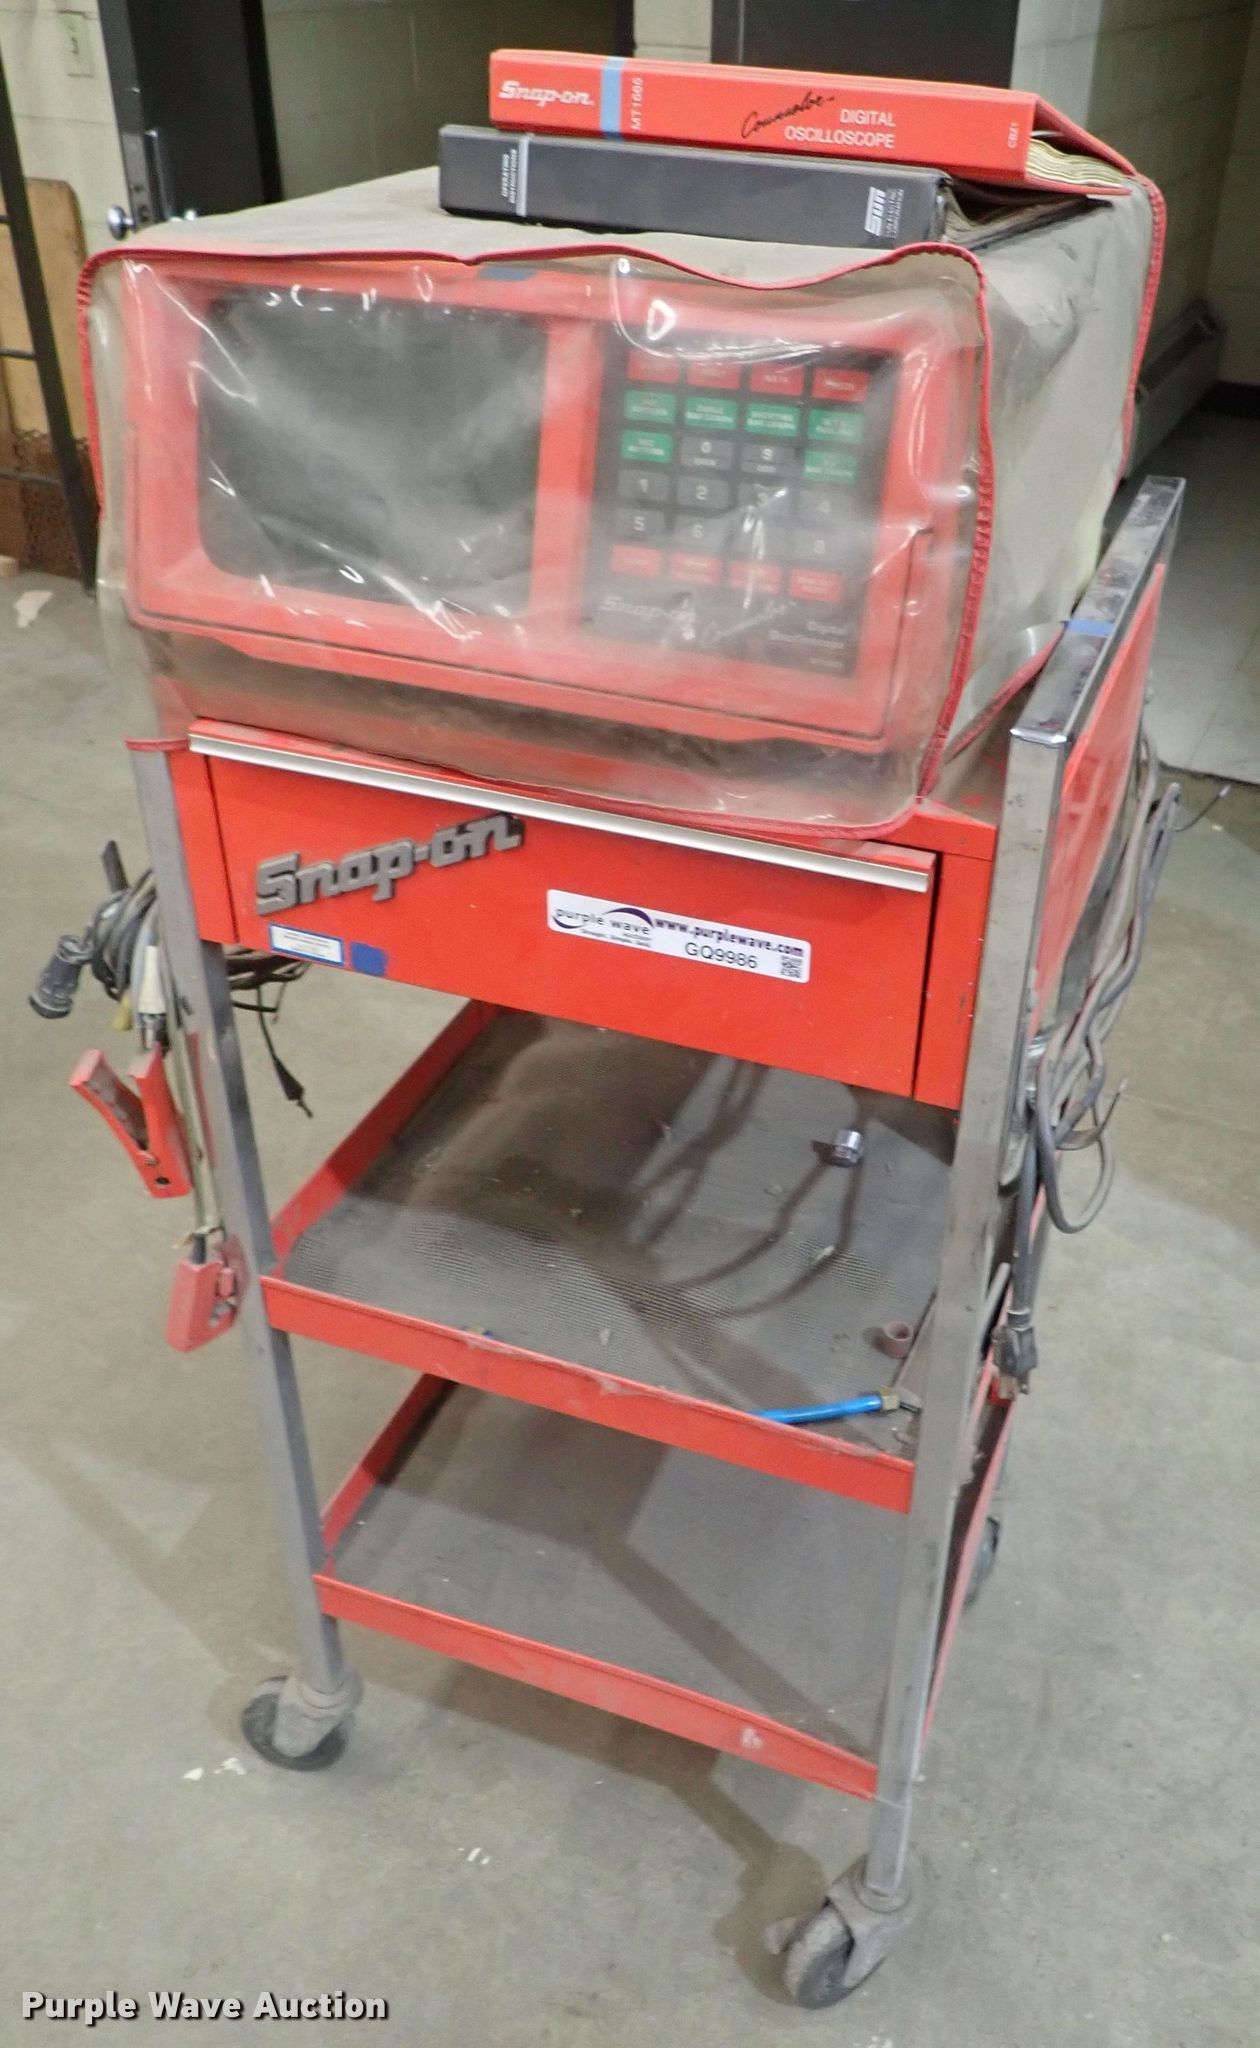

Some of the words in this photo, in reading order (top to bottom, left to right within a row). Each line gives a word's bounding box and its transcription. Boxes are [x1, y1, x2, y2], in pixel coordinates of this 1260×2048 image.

[498, 80, 592, 107] Snap-on
[840, 108, 896, 127] DIGITAL
[785, 126, 895, 149] OSCILLOSCOPE
[638, 478, 649, 494] 1
[696, 485, 708, 501] 2
[633, 516, 646, 532] 5
[256, 813, 524, 916] Snap-on
[556, 908, 604, 925] purple
[610, 920, 650, 935] wave
[654, 918, 803, 957] www.purplewave.com
[685, 942, 757, 968] GQ9986
